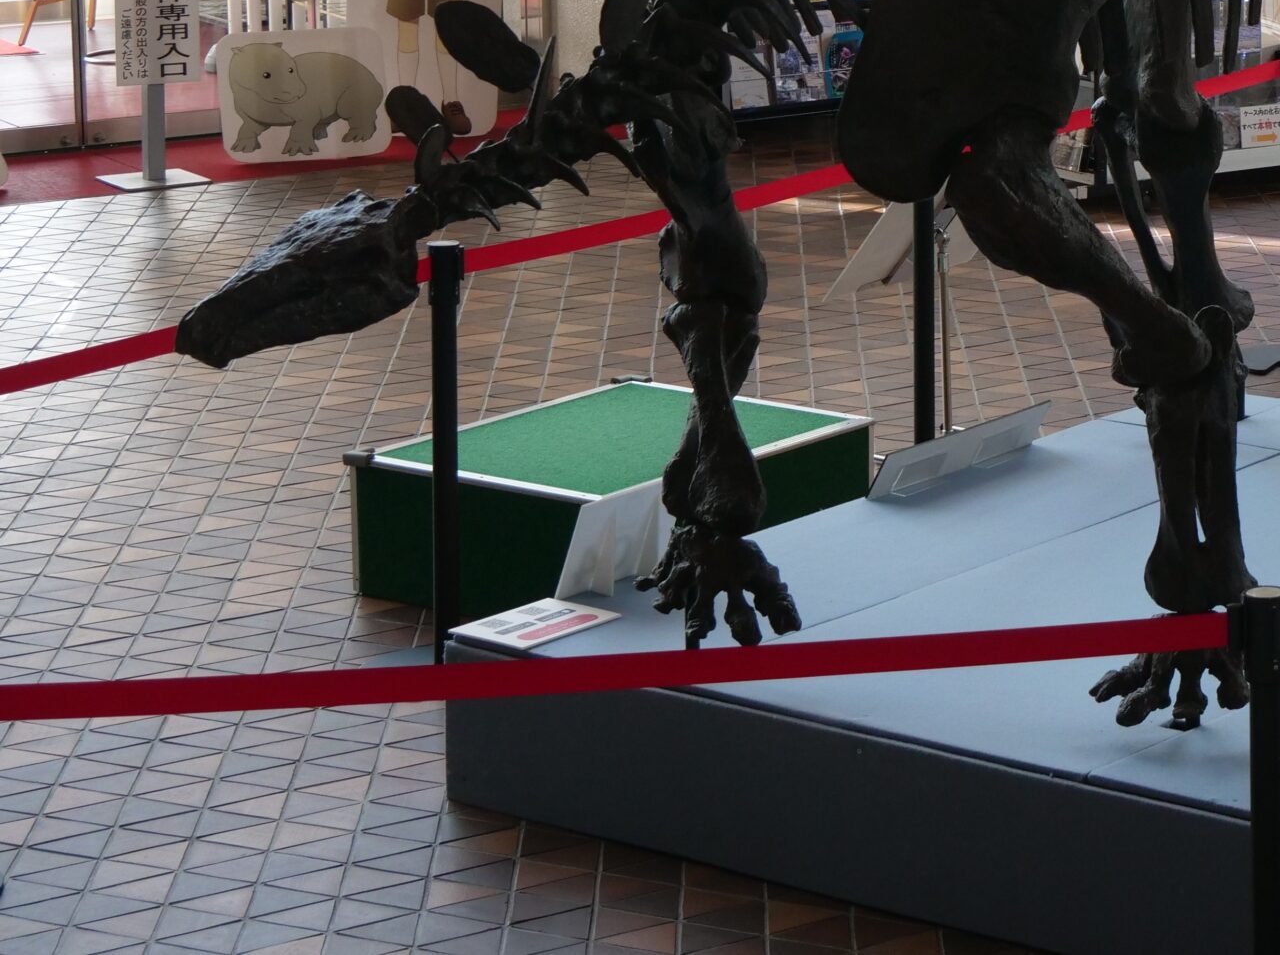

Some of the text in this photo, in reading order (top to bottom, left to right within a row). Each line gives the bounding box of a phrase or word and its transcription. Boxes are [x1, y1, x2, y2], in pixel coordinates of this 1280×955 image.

[120, 7, 133, 80] ご遠慮ください
